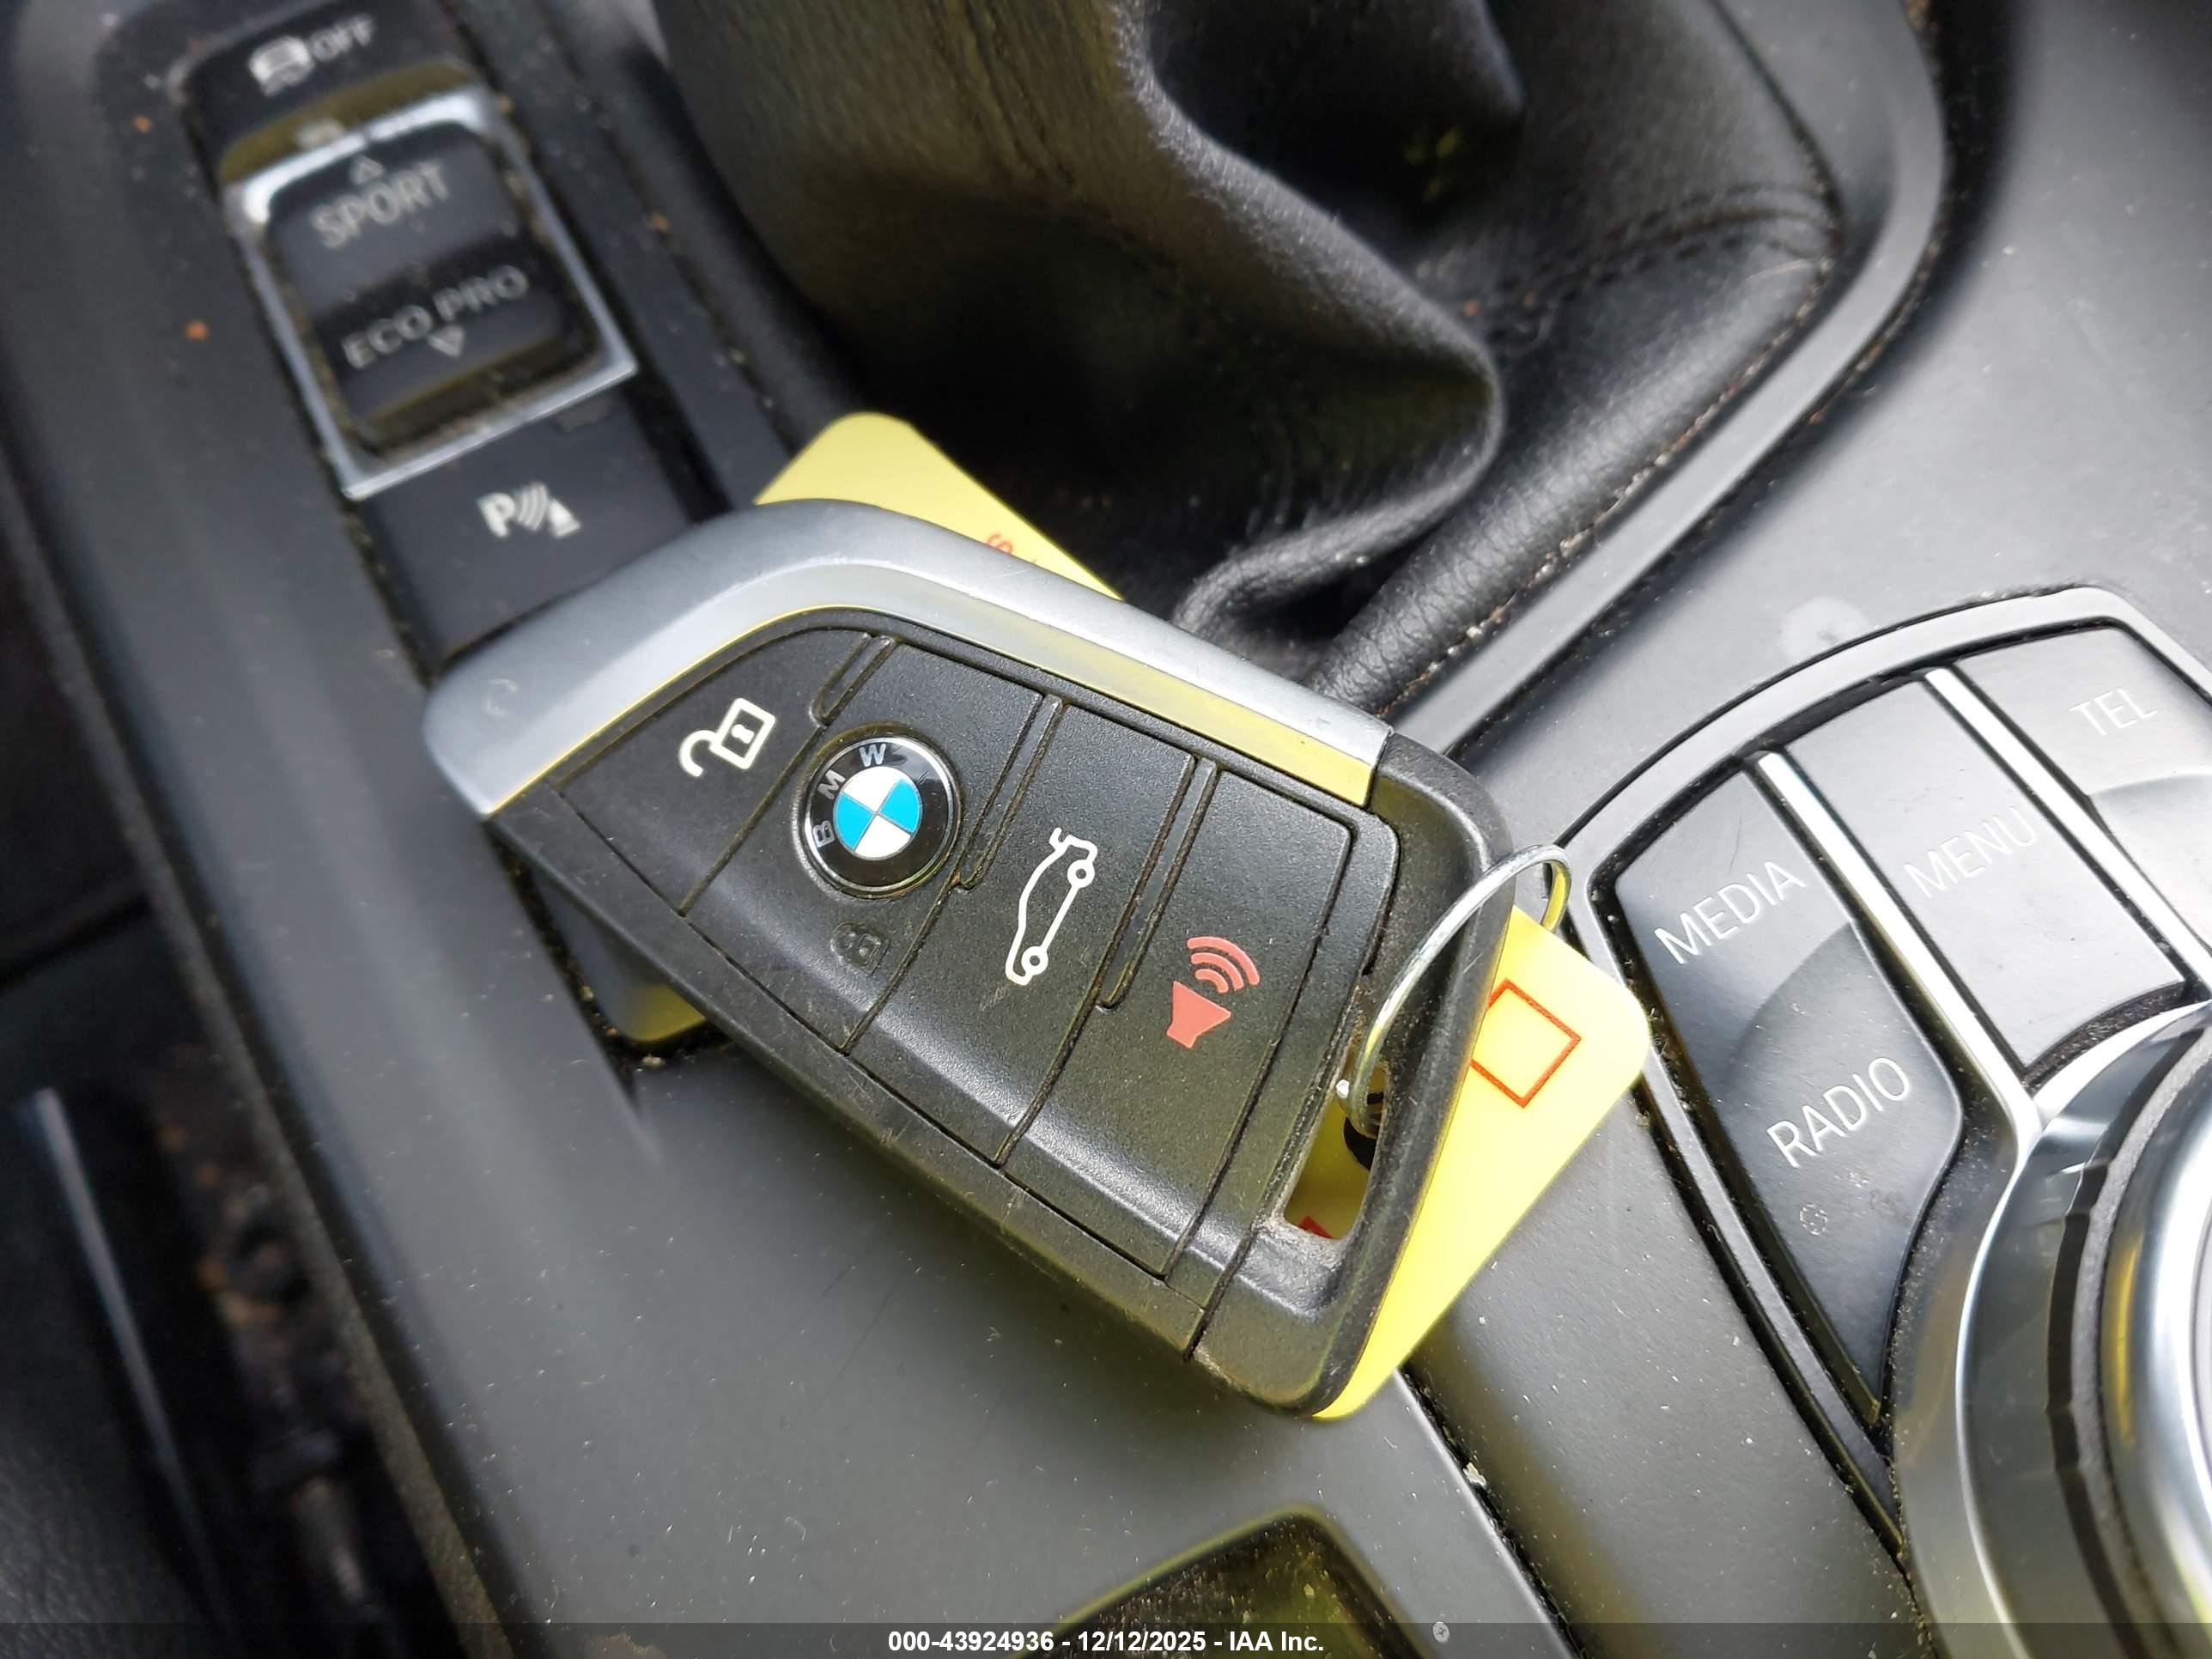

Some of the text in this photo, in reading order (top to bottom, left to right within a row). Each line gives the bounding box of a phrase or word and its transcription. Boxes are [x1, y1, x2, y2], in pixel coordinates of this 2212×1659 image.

[311, 15, 374, 61] OFF
[311, 158, 449, 249] SPORT
[343, 264, 529, 369] ECO PRO
[2069, 688, 2157, 736] TEL
[812, 744, 887, 849] BMW
[1904, 807, 2038, 899] MENU
[1654, 861, 1808, 964] MEDIA
[1766, 1057, 1911, 1168] RADIO
